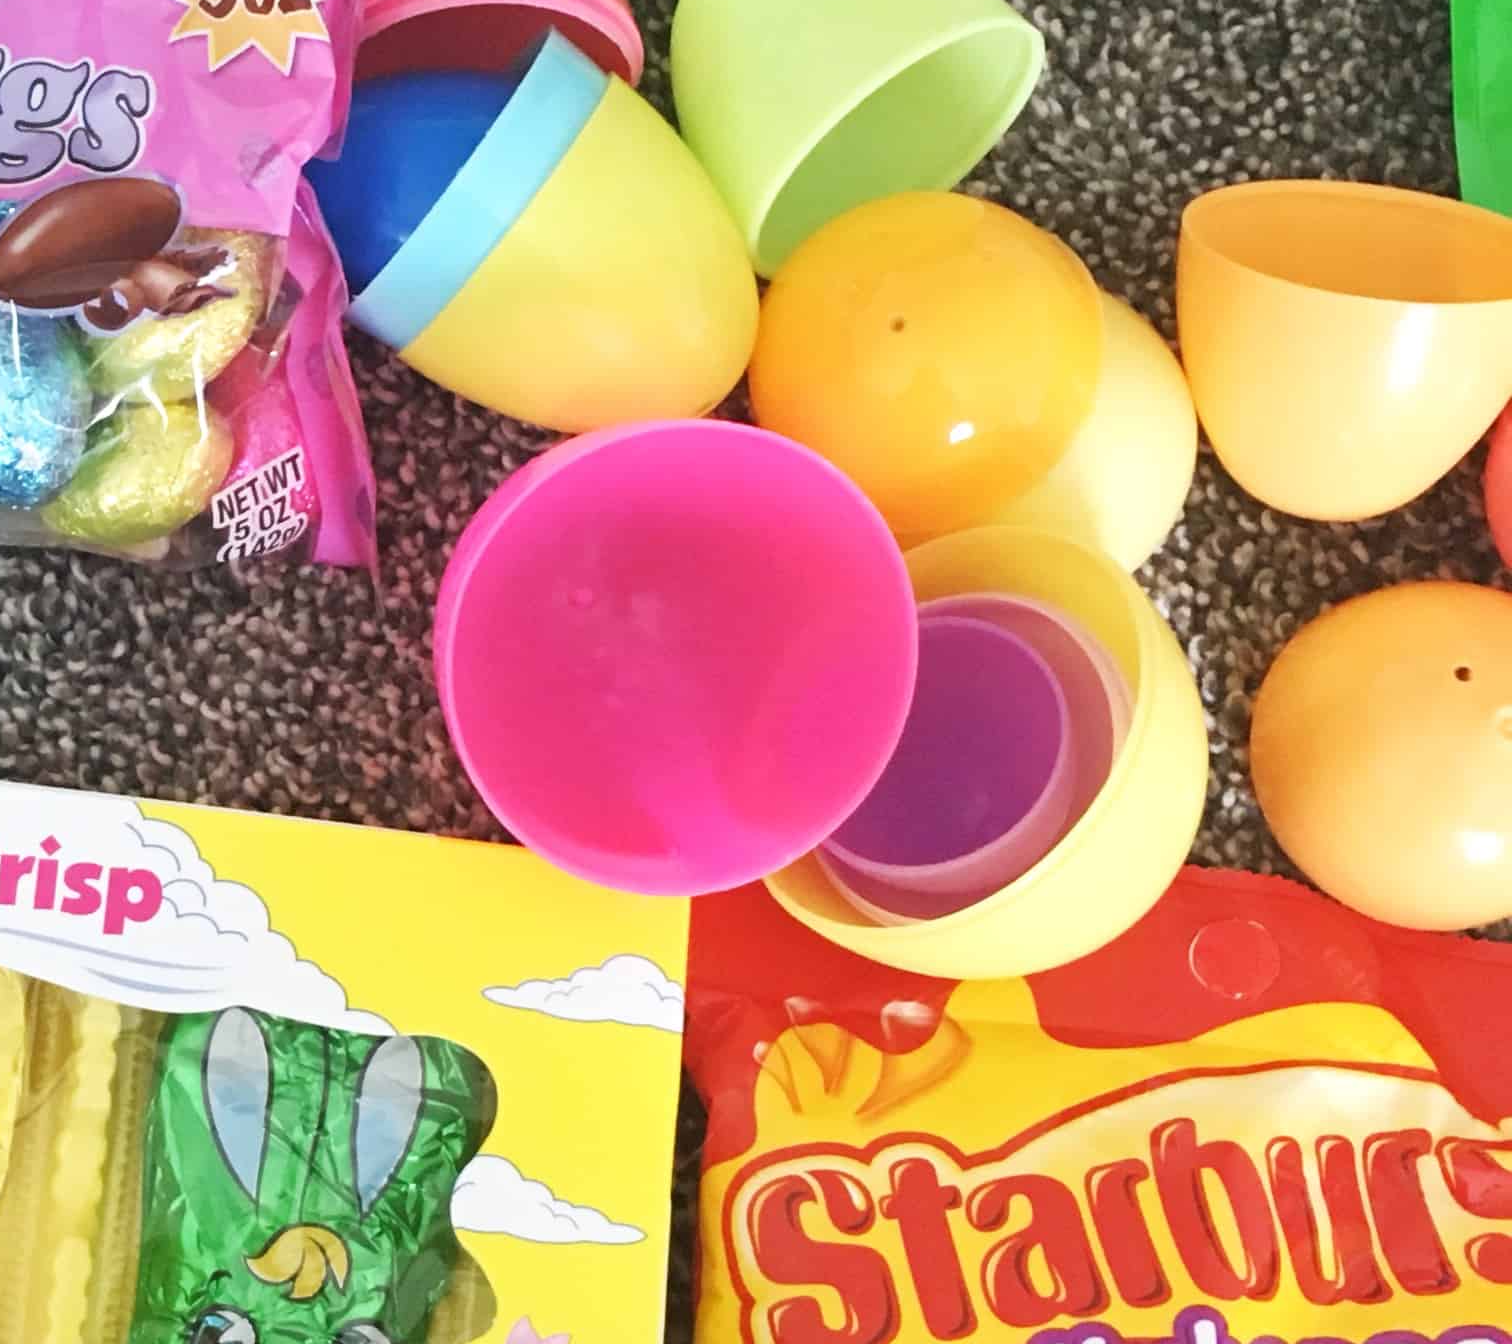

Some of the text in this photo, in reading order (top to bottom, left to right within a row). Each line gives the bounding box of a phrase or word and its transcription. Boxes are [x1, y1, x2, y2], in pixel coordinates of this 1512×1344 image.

[216, 453, 302, 524] NET WT
[234, 495, 291, 541] 5 OZ
